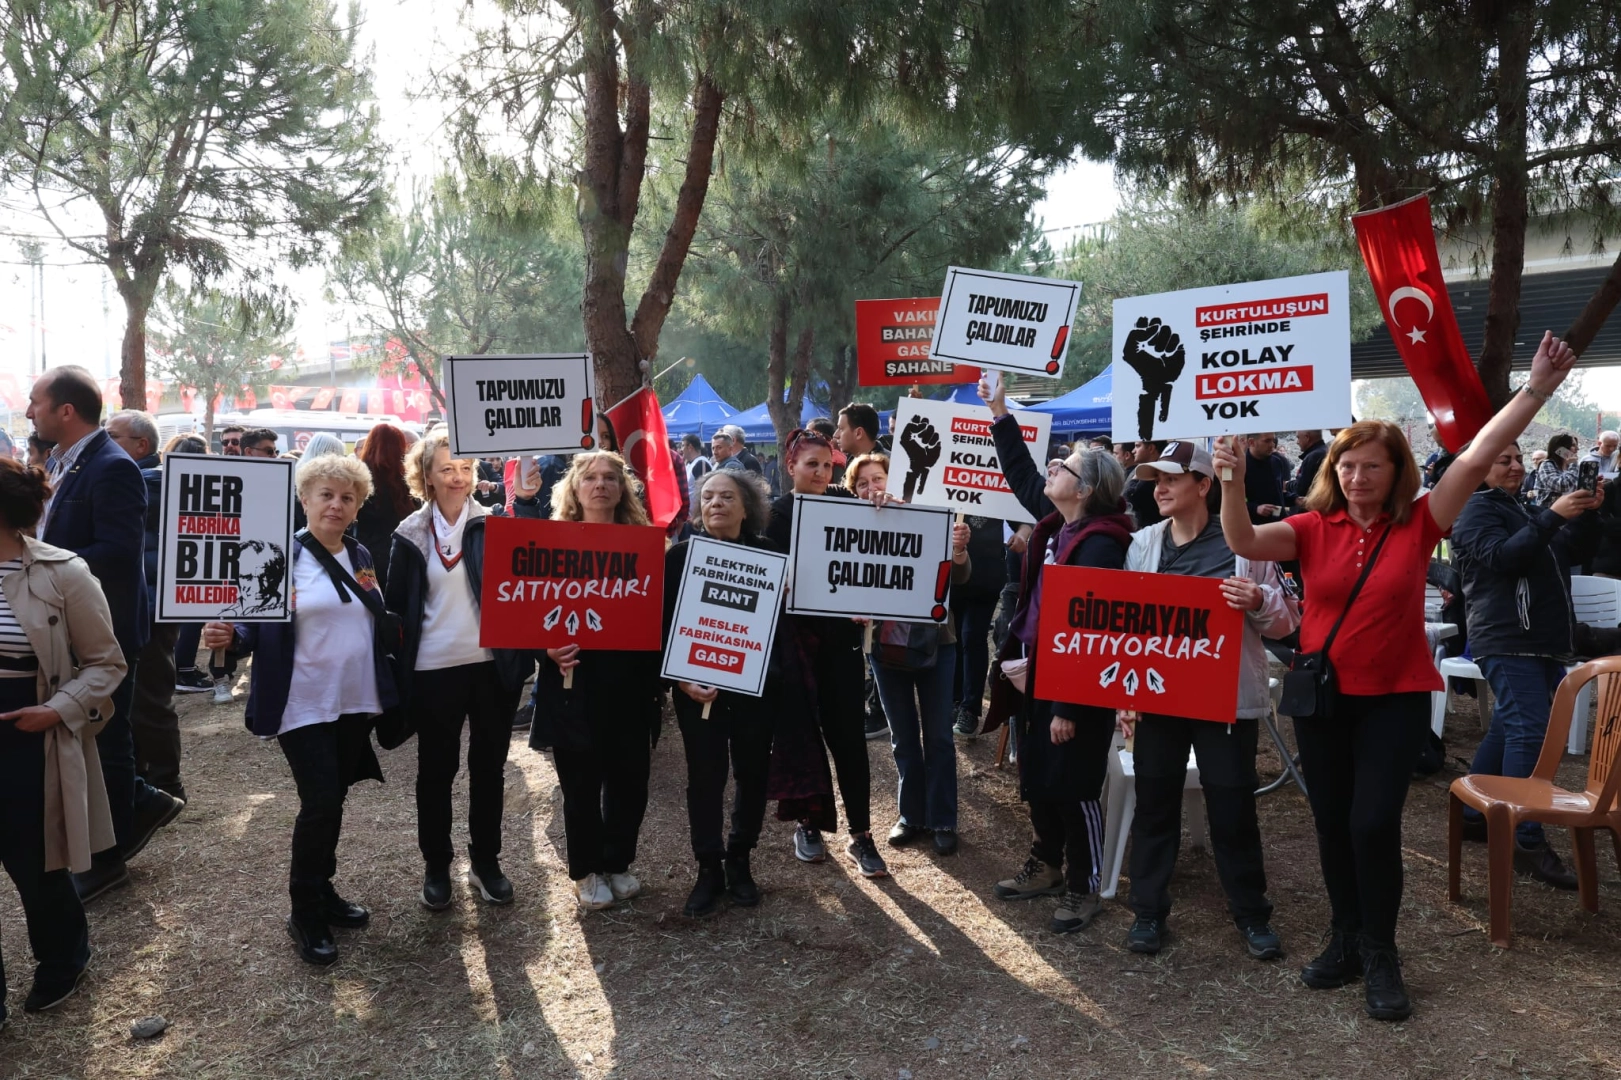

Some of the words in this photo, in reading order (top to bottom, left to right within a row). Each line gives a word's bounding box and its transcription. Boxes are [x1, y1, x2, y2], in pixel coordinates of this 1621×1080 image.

[968, 294, 1048, 322] TAPUMUZU
[1200, 299, 1324, 323] KURTULUŞUN
[883, 328, 934, 340] BAHAN
[966, 320, 1037, 348] ÇALDILAR
[1200, 320, 1291, 343] ŞEHRİNDE
[898, 345, 930, 356] GAS
[1202, 344, 1295, 370] KOLAY
[886, 362, 953, 377] ŞAHANE
[476, 378, 566, 401] TAPUMUZU
[1201, 370, 1303, 395] LOKMA
[484, 406, 562, 436] ÇALDILAR
[1200, 400, 1260, 421] YOK
[952, 434, 995, 447] ŞEHRİN
[950, 451, 999, 469] KOLA
[179, 473, 243, 513] HER
[945, 488, 983, 504] YOK
[177, 512, 240, 535] FABRİKA
[824, 526, 923, 558] TAPUMUZU
[176, 534, 240, 579] BİR
[511, 541, 638, 581] GİDERAYAK
[705, 556, 768, 577] ELEKTRİK
[497, 575, 650, 602] SATIYORLAR!
[692, 566, 775, 591] FABRİKASINA
[827, 560, 914, 593] ÇALDILAR
[175, 580, 238, 604] KALEDİR
[707, 587, 753, 606] RANT
[698, 616, 750, 635] MESLEK
[1068, 591, 1211, 640] GİDERAYAK
[679, 626, 762, 651] FABRİKASINA
[1052, 632, 1226, 660] SATIYORLAR!
[694, 649, 739, 667] GASP
